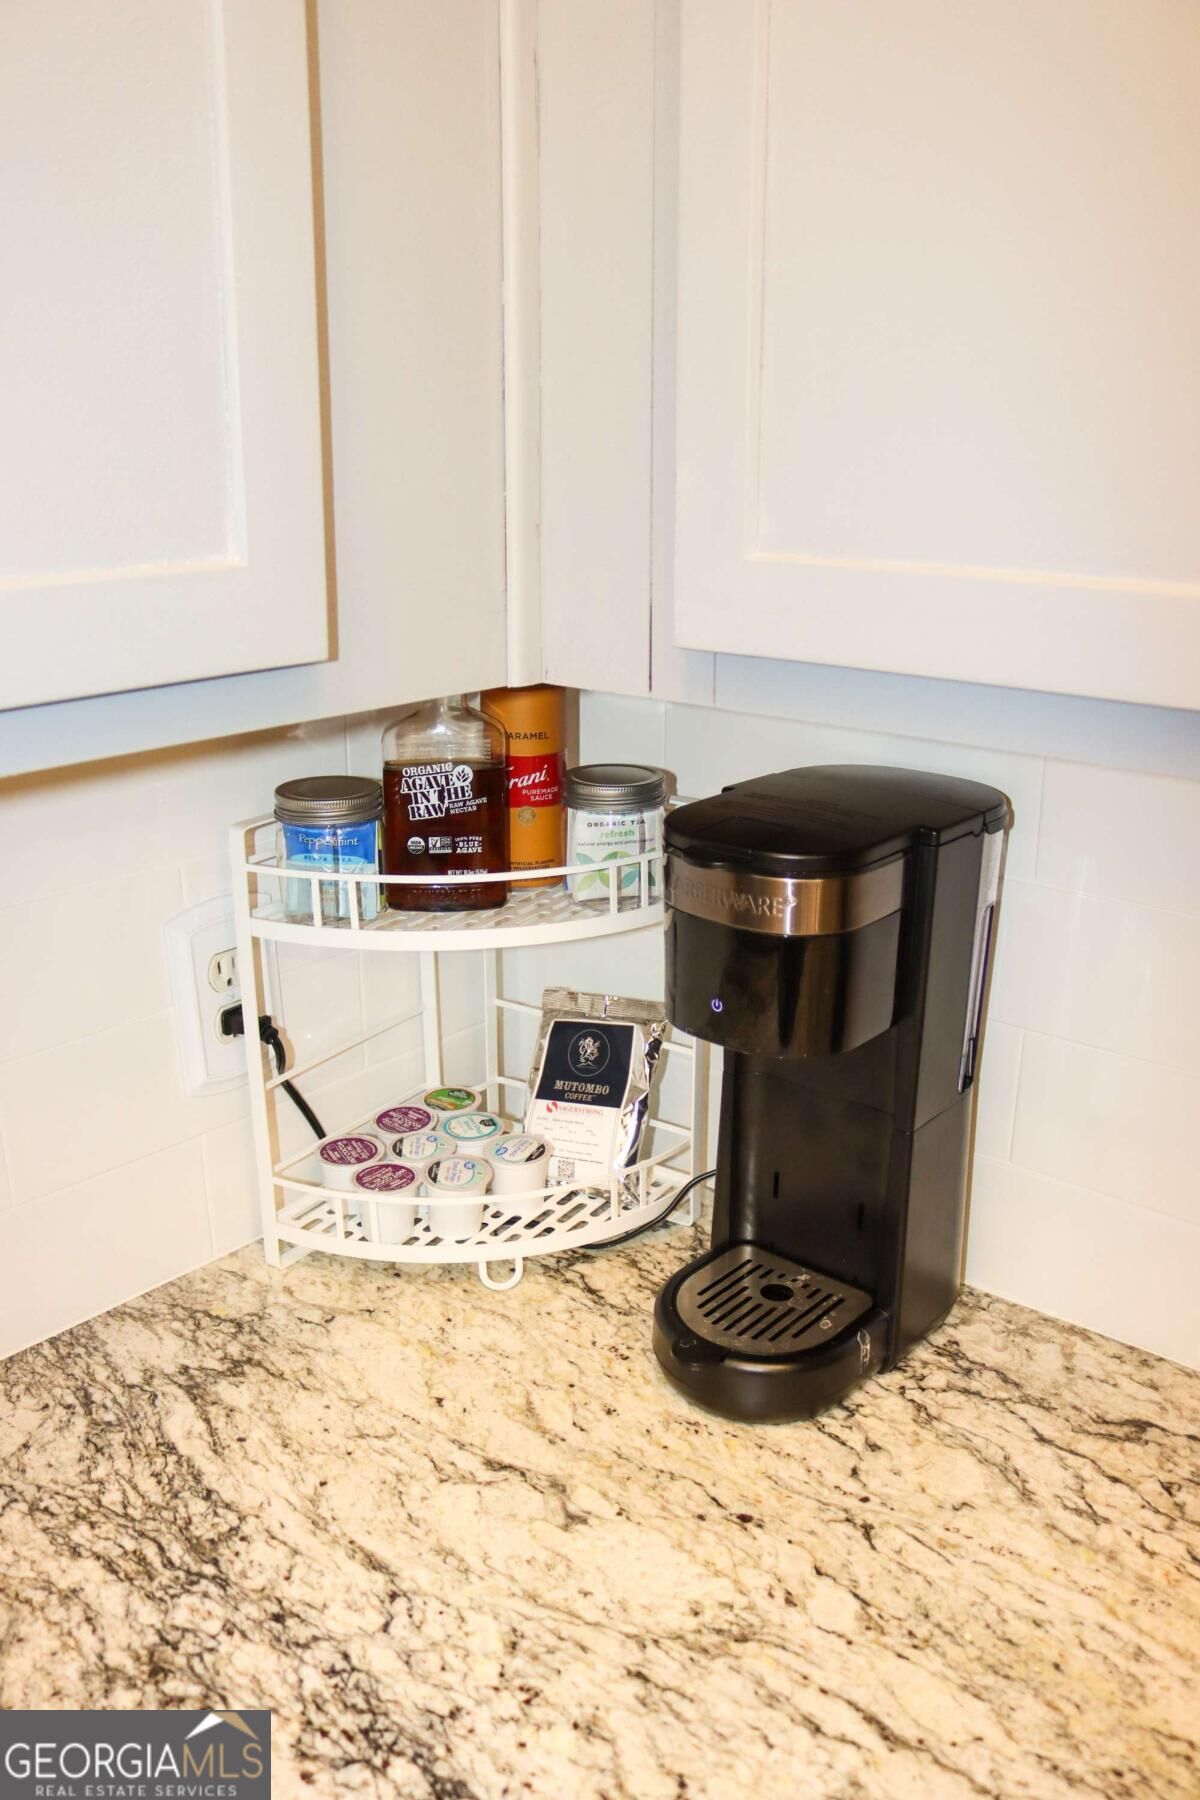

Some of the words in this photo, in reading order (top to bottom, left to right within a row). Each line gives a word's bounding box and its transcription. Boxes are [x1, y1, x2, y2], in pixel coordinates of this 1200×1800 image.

[506, 731, 549, 741] ARAMEL
[402, 762, 453, 777] ORGANIC
[505, 764, 548, 789] rani
[401, 773, 456, 793] AGAVE
[522, 786, 558, 796] PUREMADE
[411, 790, 431, 806] IN
[530, 793, 553, 801] SAUCE
[449, 801, 464, 809] RAW
[465, 797, 488, 806] AGAVE
[408, 802, 446, 820] RAW
[450, 805, 477, 815] NECTAR
[587, 820, 626, 828] ORGANIC
[600, 829, 635, 839] refresh
[553, 1080, 610, 1095] MUTOMBO
[564, 1092, 593, 1102] COFFEE
